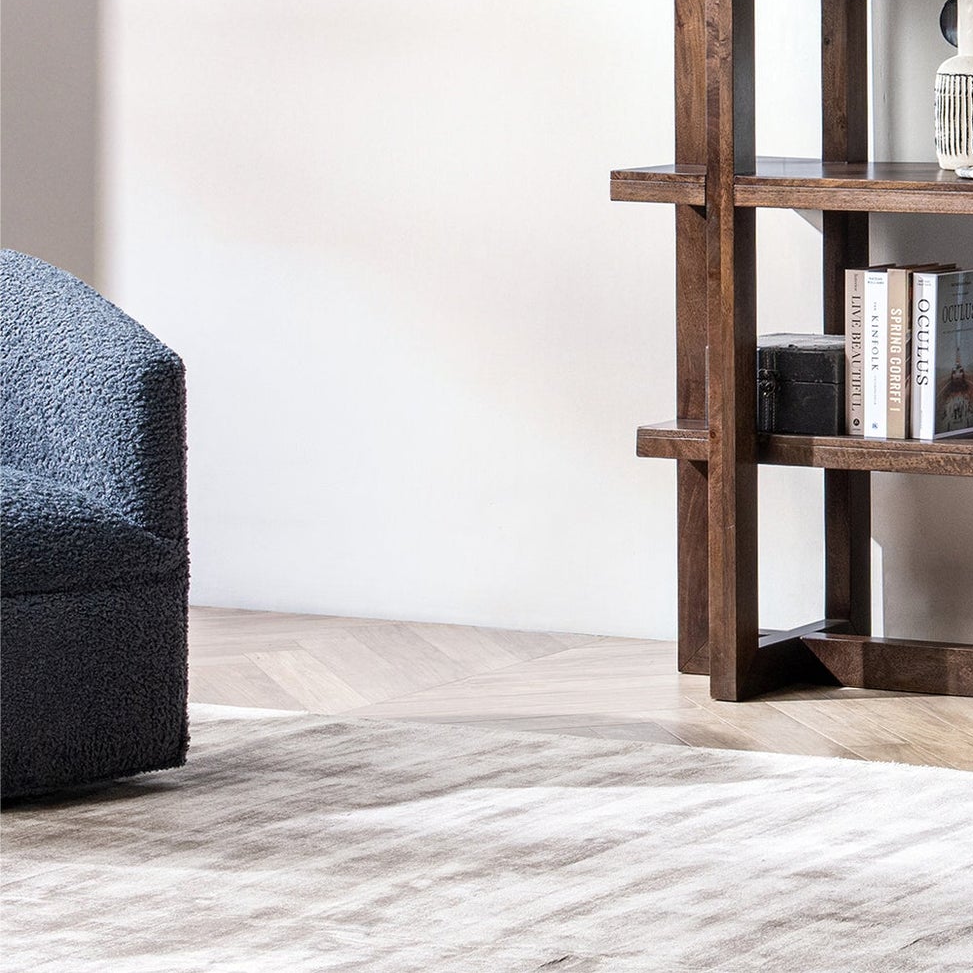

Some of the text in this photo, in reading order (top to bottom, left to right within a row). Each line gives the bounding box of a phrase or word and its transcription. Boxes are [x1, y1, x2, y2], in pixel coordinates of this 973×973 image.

[851, 295, 861, 327] LIVE
[890, 308, 902, 353] SPRING
[871, 315, 879, 371] KINFOLK
[916, 298, 930, 385] OCULUS
[851, 332, 861, 411] BEAUTIFUL
